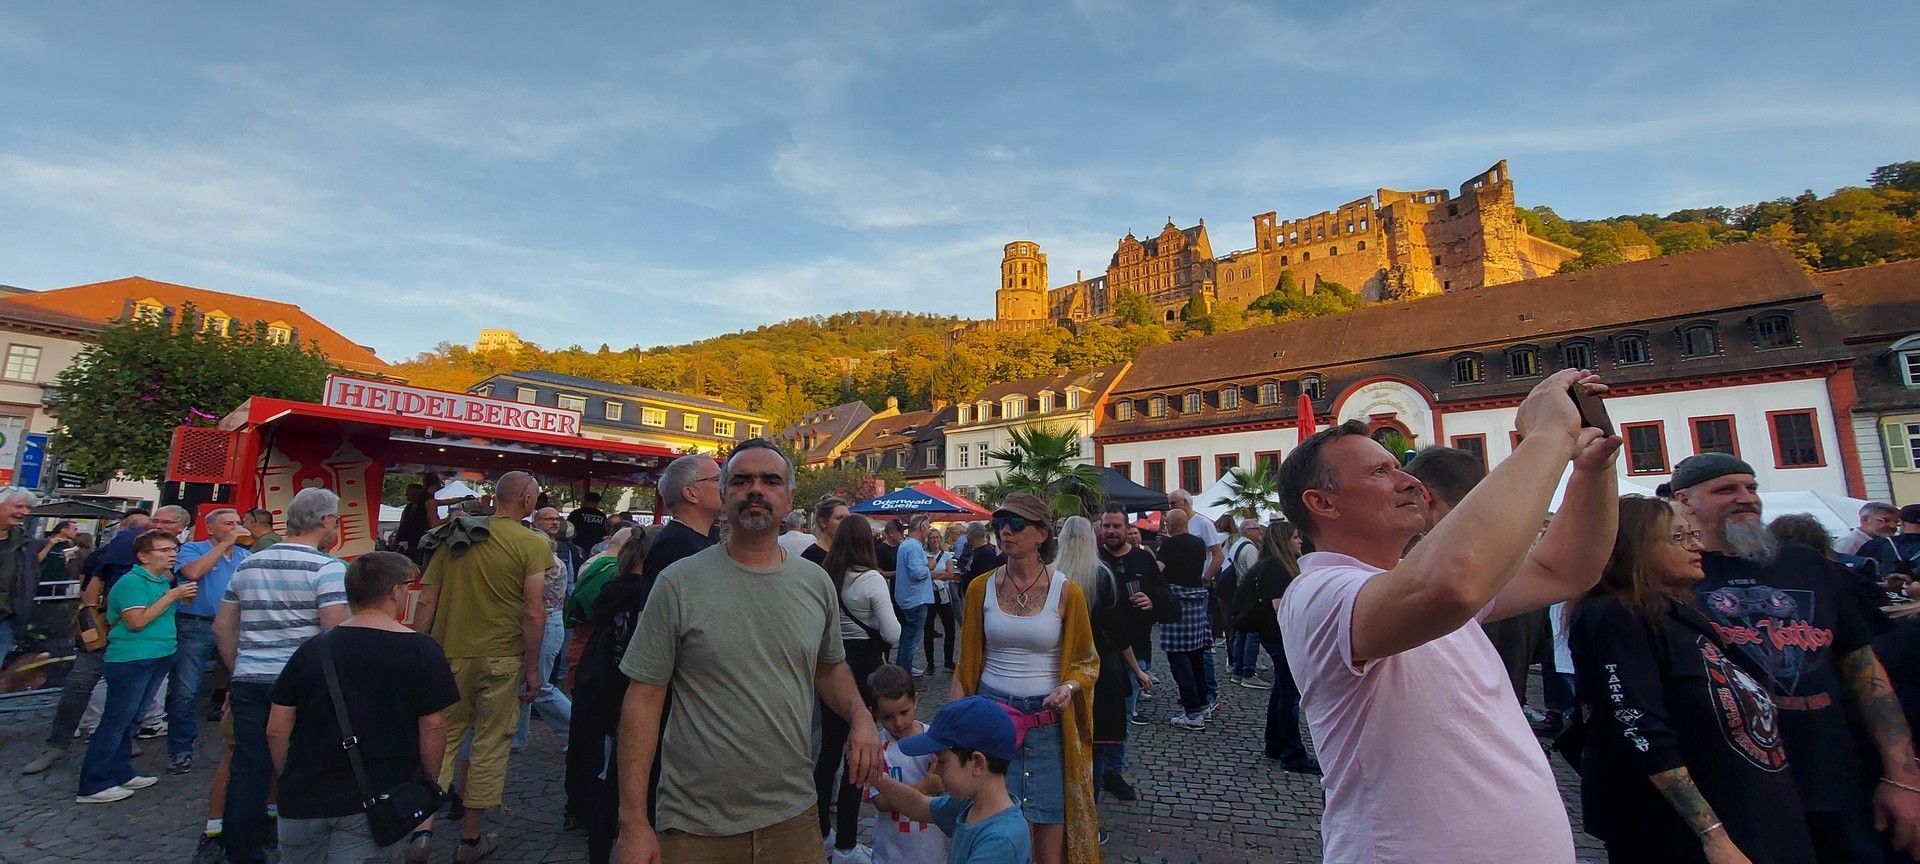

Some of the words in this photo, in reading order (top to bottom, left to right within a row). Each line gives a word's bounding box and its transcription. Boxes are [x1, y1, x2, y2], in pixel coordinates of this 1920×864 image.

[336, 383, 576, 434] HEIDELBERGER
[583, 516, 603, 525] TEAM
[1756, 619, 1833, 652] Tattoo
